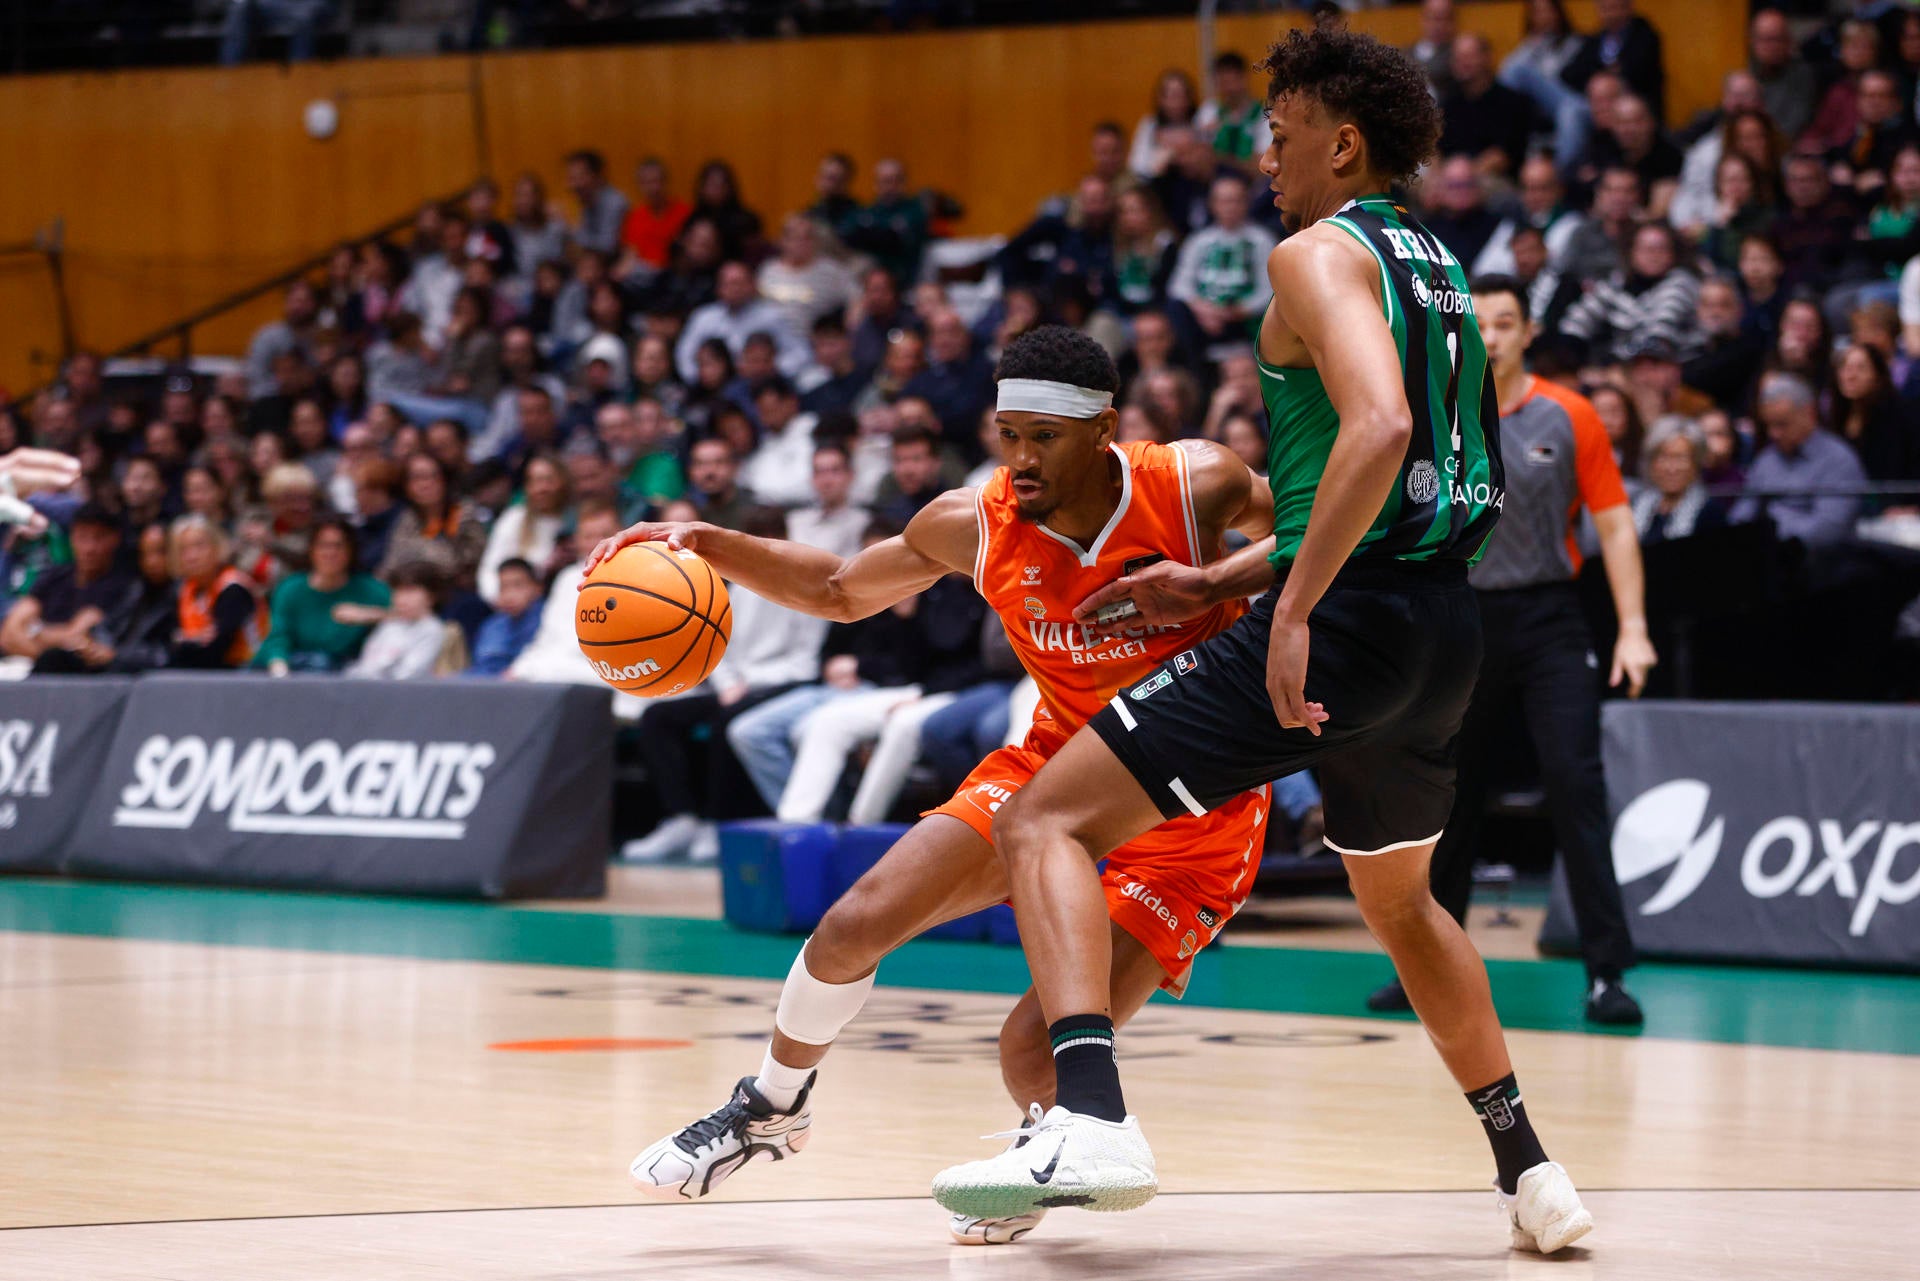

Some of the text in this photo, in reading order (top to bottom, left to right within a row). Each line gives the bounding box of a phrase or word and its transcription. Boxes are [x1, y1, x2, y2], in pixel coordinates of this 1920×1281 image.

[580, 606, 607, 624] acb
[1029, 619, 1182, 652] VALE
[1071, 638, 1148, 665] BASKET
[118, 735, 496, 824] SOMDOCENTS
[1120, 881, 1179, 931] Midea
[1199, 910, 1214, 926] acb
